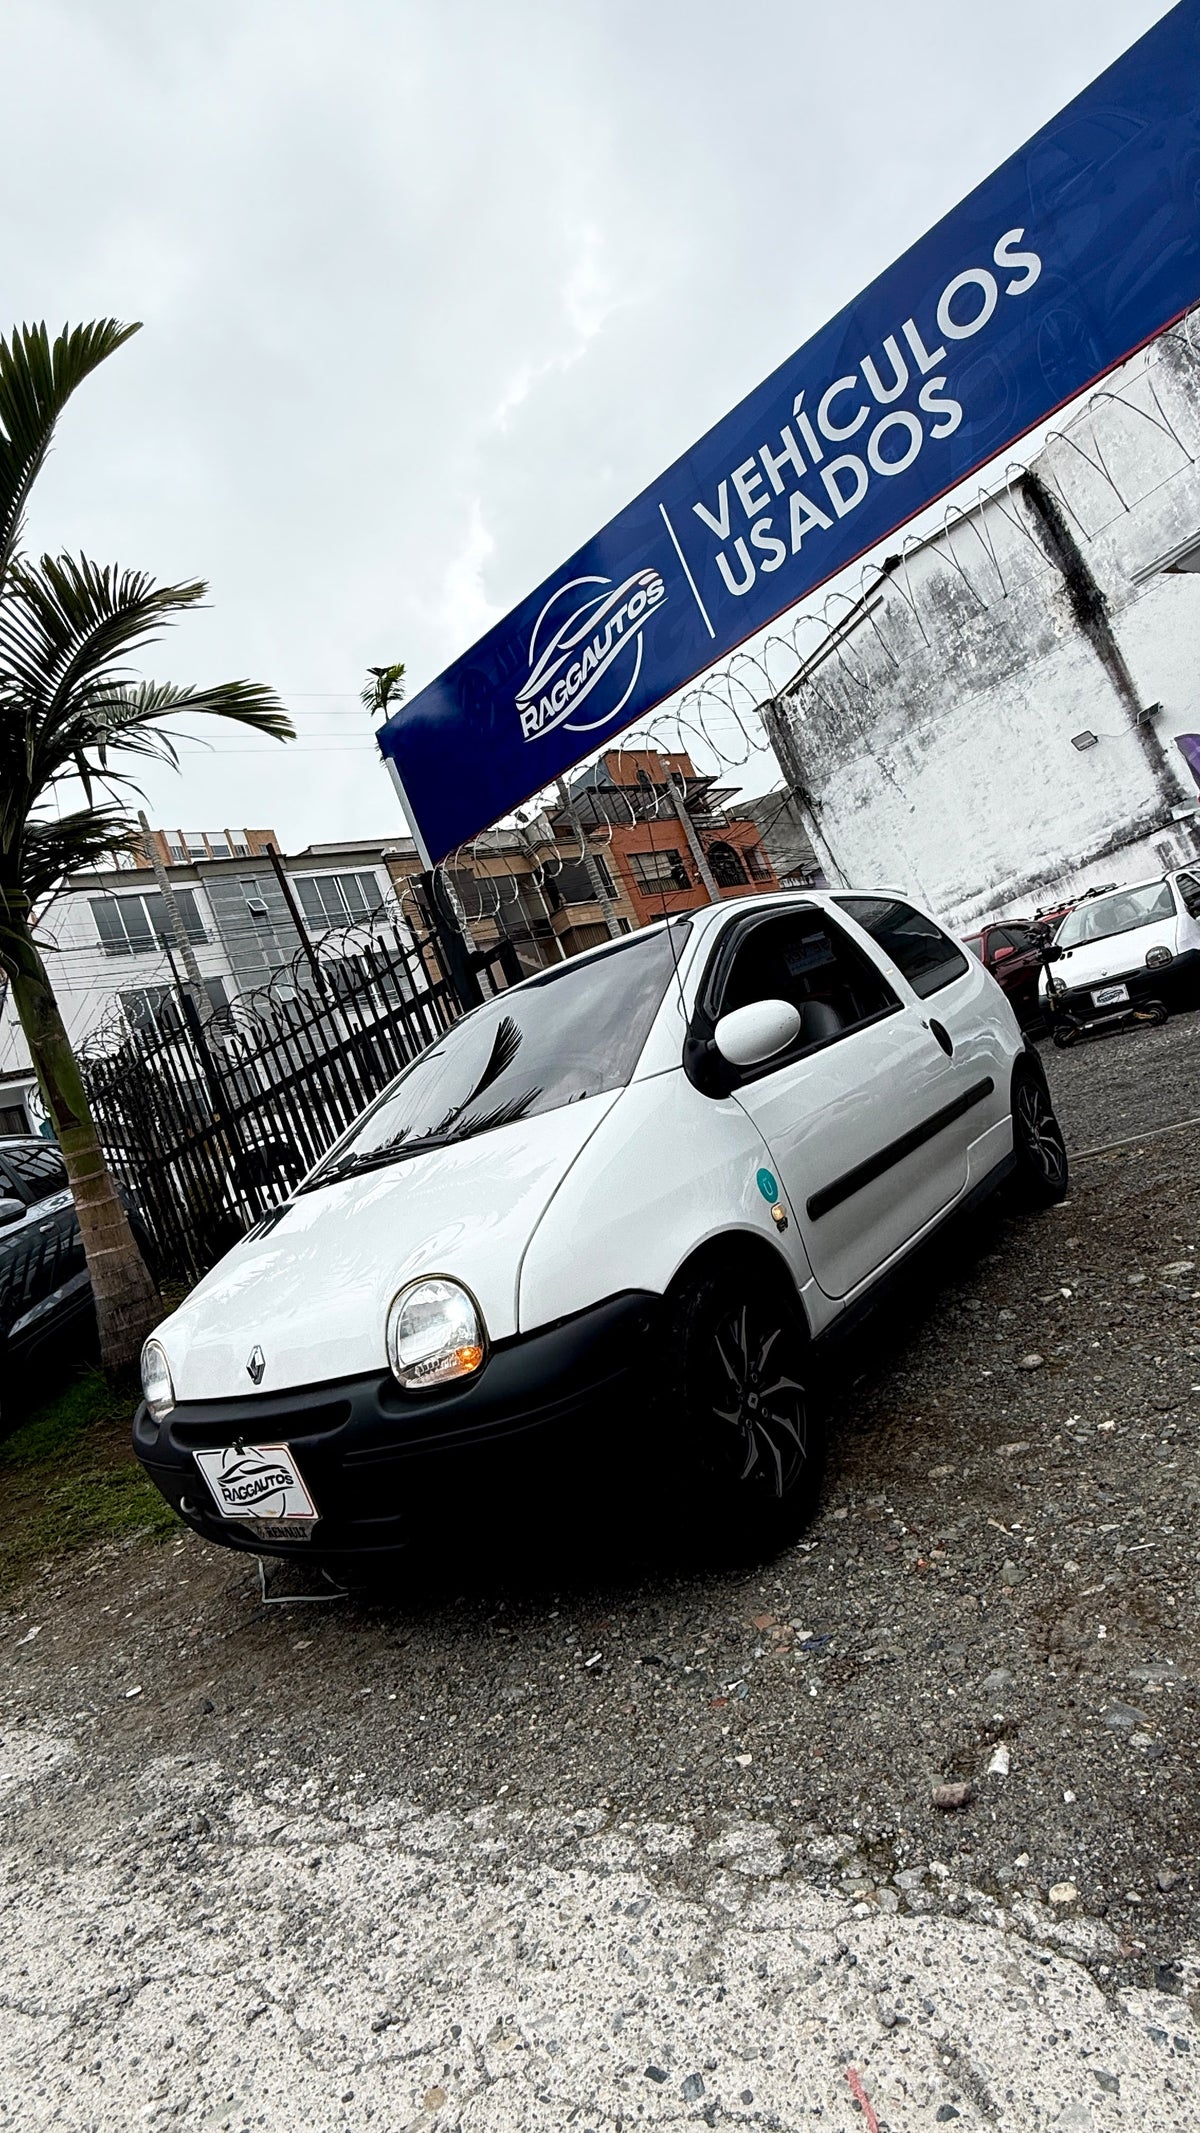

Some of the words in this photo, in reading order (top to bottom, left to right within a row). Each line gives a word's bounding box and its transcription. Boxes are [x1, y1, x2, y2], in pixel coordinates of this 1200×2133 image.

[692, 228, 1042, 541] VEHÍCULOS
[715, 376, 963, 597] USADOS
[520, 578, 665, 738] RAGGAUTOS
[221, 1474, 294, 1501] RAGGAUTOS
[265, 1526, 308, 1538] RENAULT
